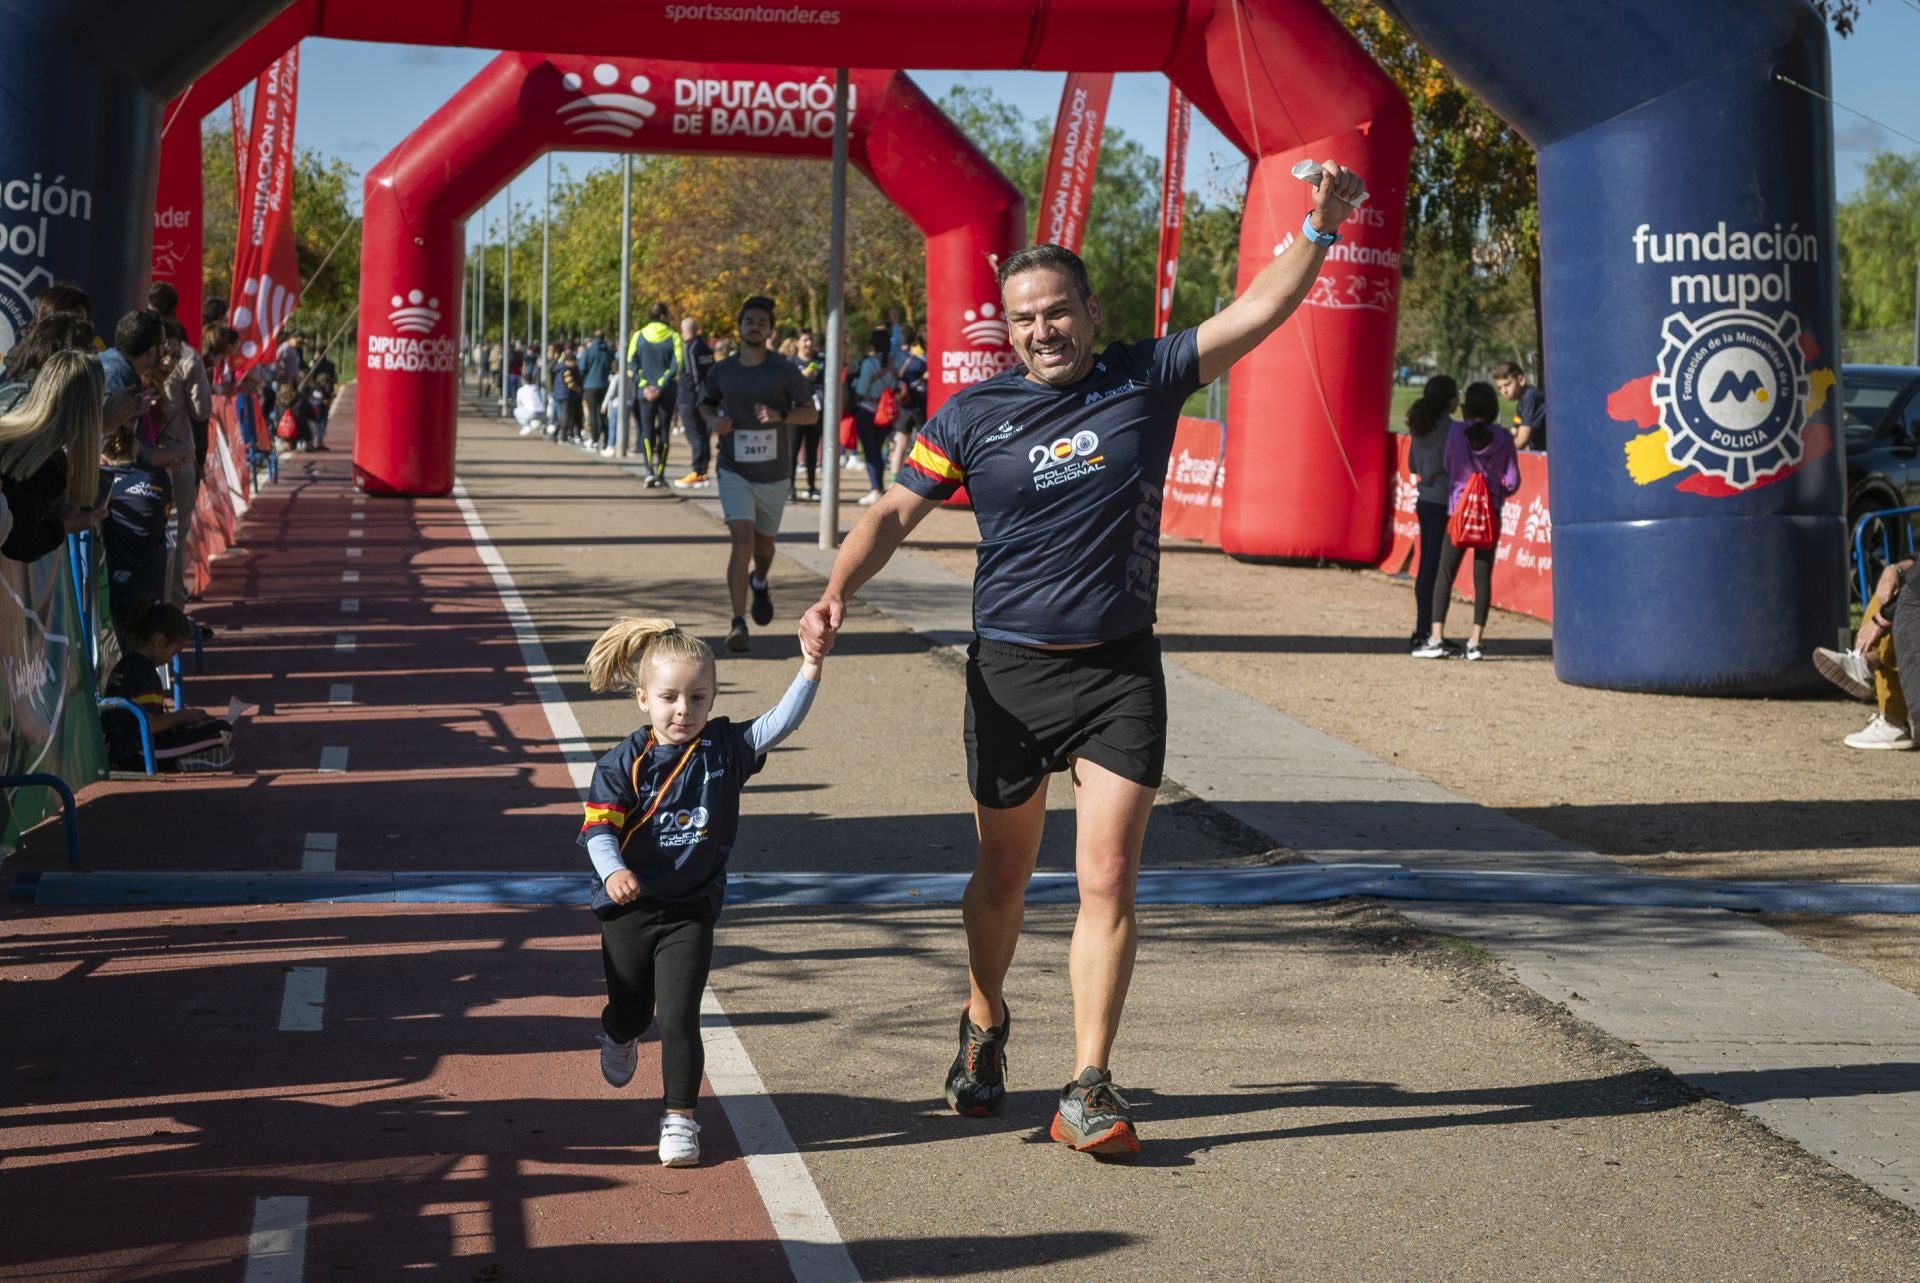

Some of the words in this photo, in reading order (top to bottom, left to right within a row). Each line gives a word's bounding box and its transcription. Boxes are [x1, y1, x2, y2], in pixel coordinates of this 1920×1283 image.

[665, 4, 841, 25] sportssantander.es
[266, 100, 276, 120] DE
[673, 114, 703, 134] DE
[1061, 87, 1088, 168] BADAJOZ
[1060, 170, 1073, 188] DE
[0, 172, 92, 221] ción
[1632, 221, 1818, 264] fundación
[1671, 263, 1791, 310] mupol
[368, 334, 455, 356] DIPUTACIÓN
[367, 354, 382, 370] DE
[384, 353, 453, 372] BADAJOZ
[1682, 346, 1709, 401] Fundación
[1708, 338, 1722, 350] de
[1722, 333, 1734, 343] la
[1736, 332, 1785, 369] Mutualidad
[942, 370, 958, 384] DE
[1710, 429, 1768, 448] POLICÍA
[1029, 430, 1099, 473] 200
[1033, 459, 1090, 483] POLICIA
[1035, 464, 1106, 491] NACIONAL
